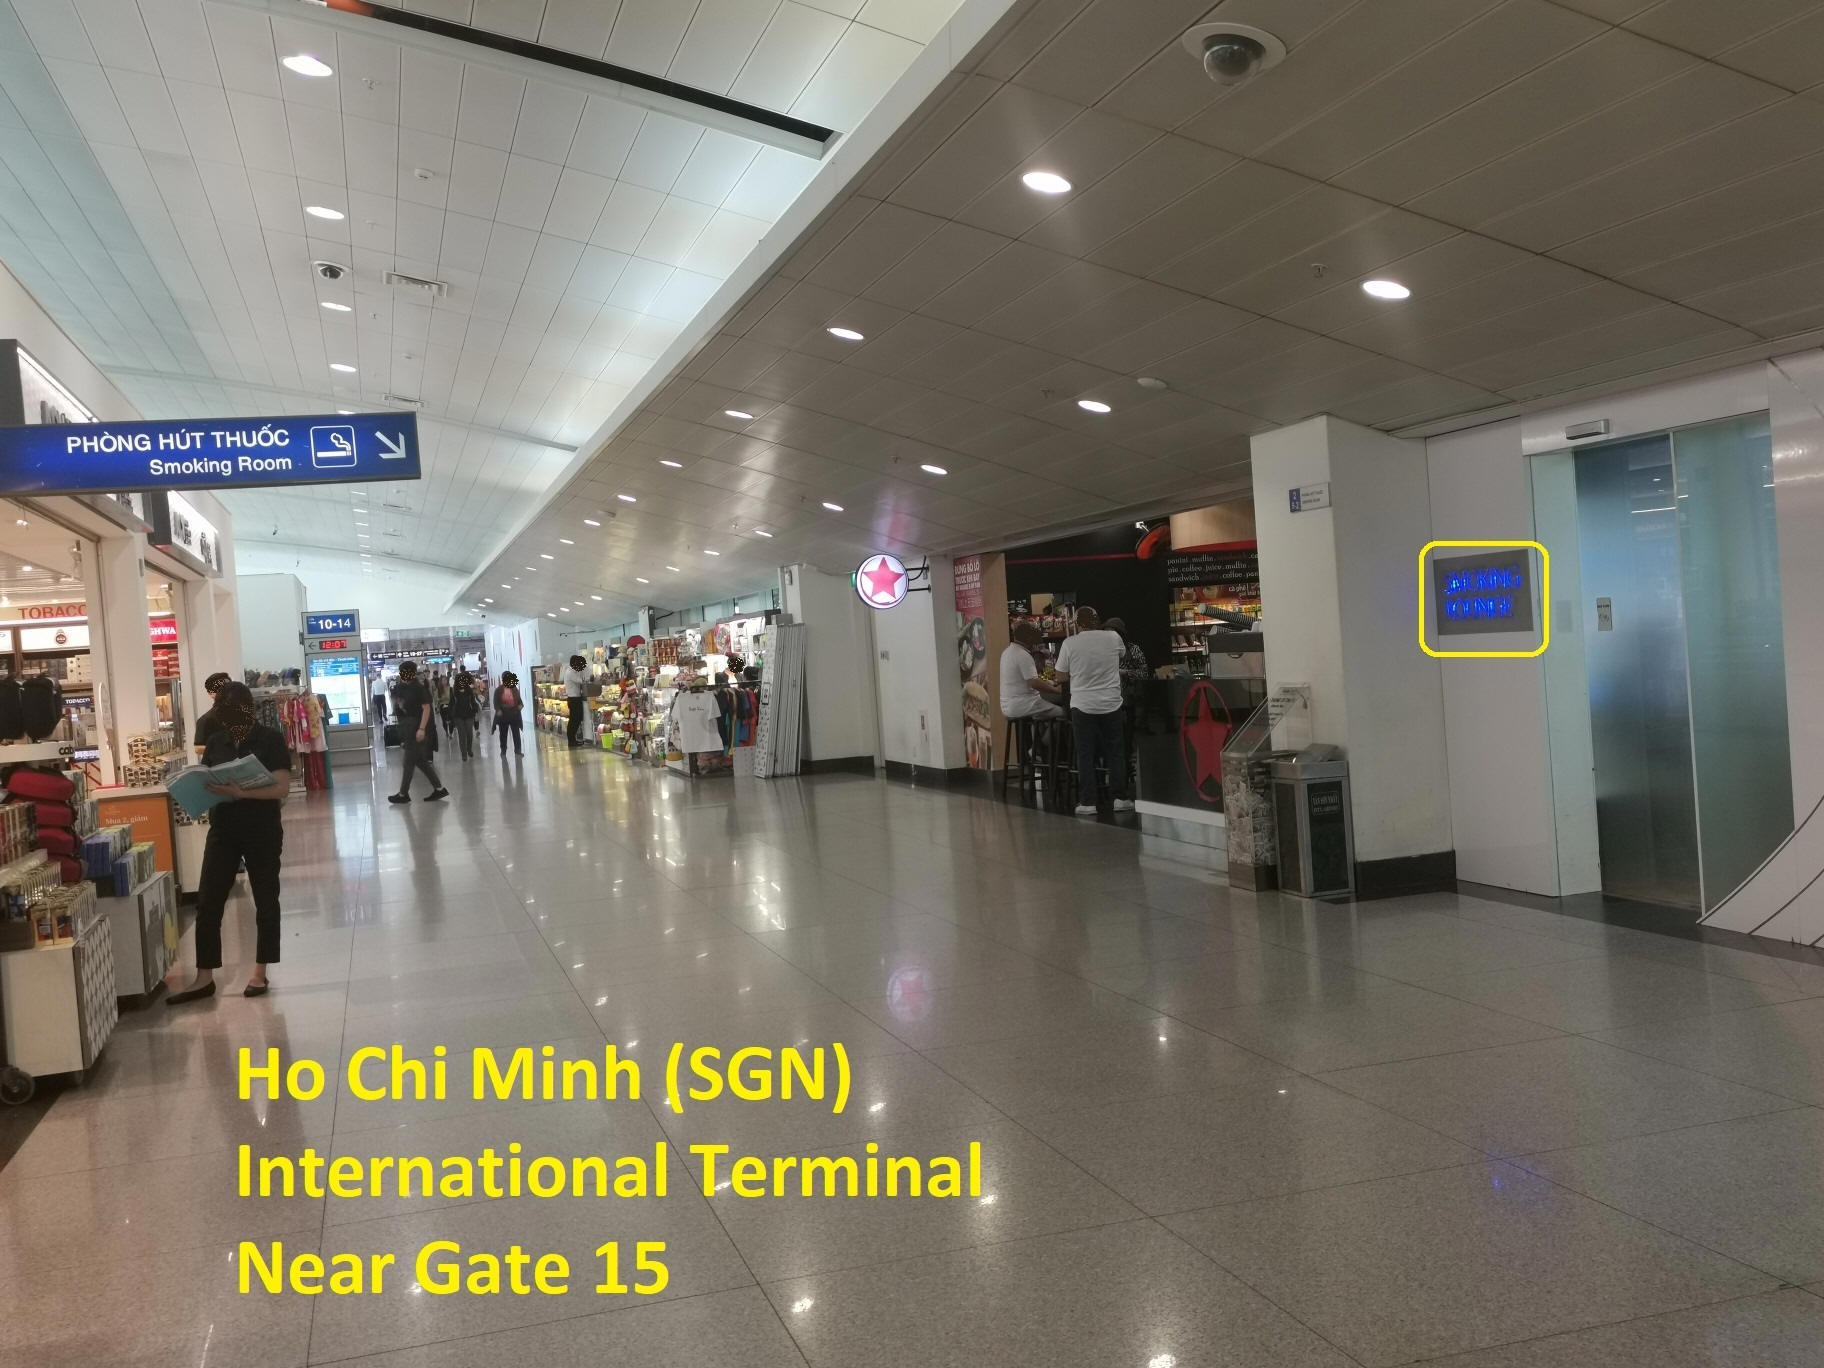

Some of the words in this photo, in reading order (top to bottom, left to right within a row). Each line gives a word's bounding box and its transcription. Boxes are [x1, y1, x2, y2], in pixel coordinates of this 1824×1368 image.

[66, 431, 151, 454] PHÒNG
[158, 429, 205, 450] HÚT
[211, 424, 290, 448] THUỐC
[150, 458, 232, 476] Smoking
[238, 456, 292, 471] Room
[318, 618, 351, 629] 10-14
[322, 640, 347, 649] 12:07
